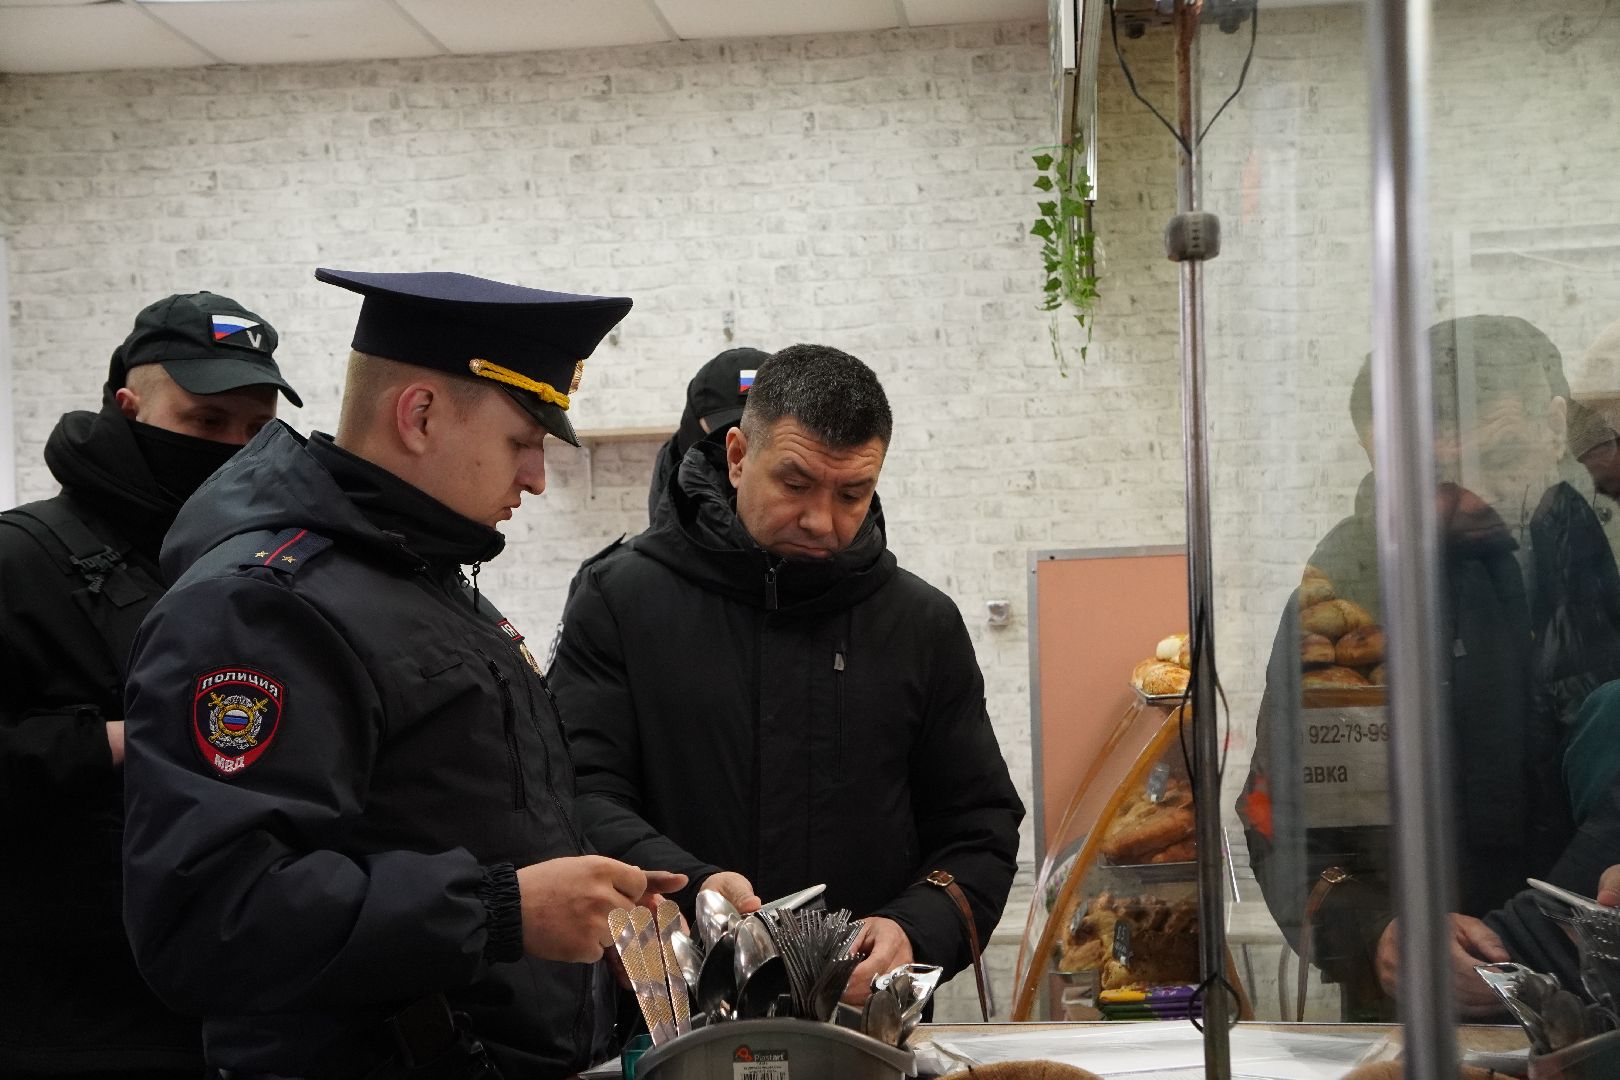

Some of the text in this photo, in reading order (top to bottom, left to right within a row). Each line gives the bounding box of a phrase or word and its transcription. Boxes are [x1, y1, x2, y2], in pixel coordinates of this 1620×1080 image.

[246, 329, 262, 349] V
[202, 672, 278, 697] ПОЛИЦИЯ
[1309, 723, 1390, 745] 922-73-99
[214, 754, 245, 773] МВД
[1303, 765, 1348, 784] авка
